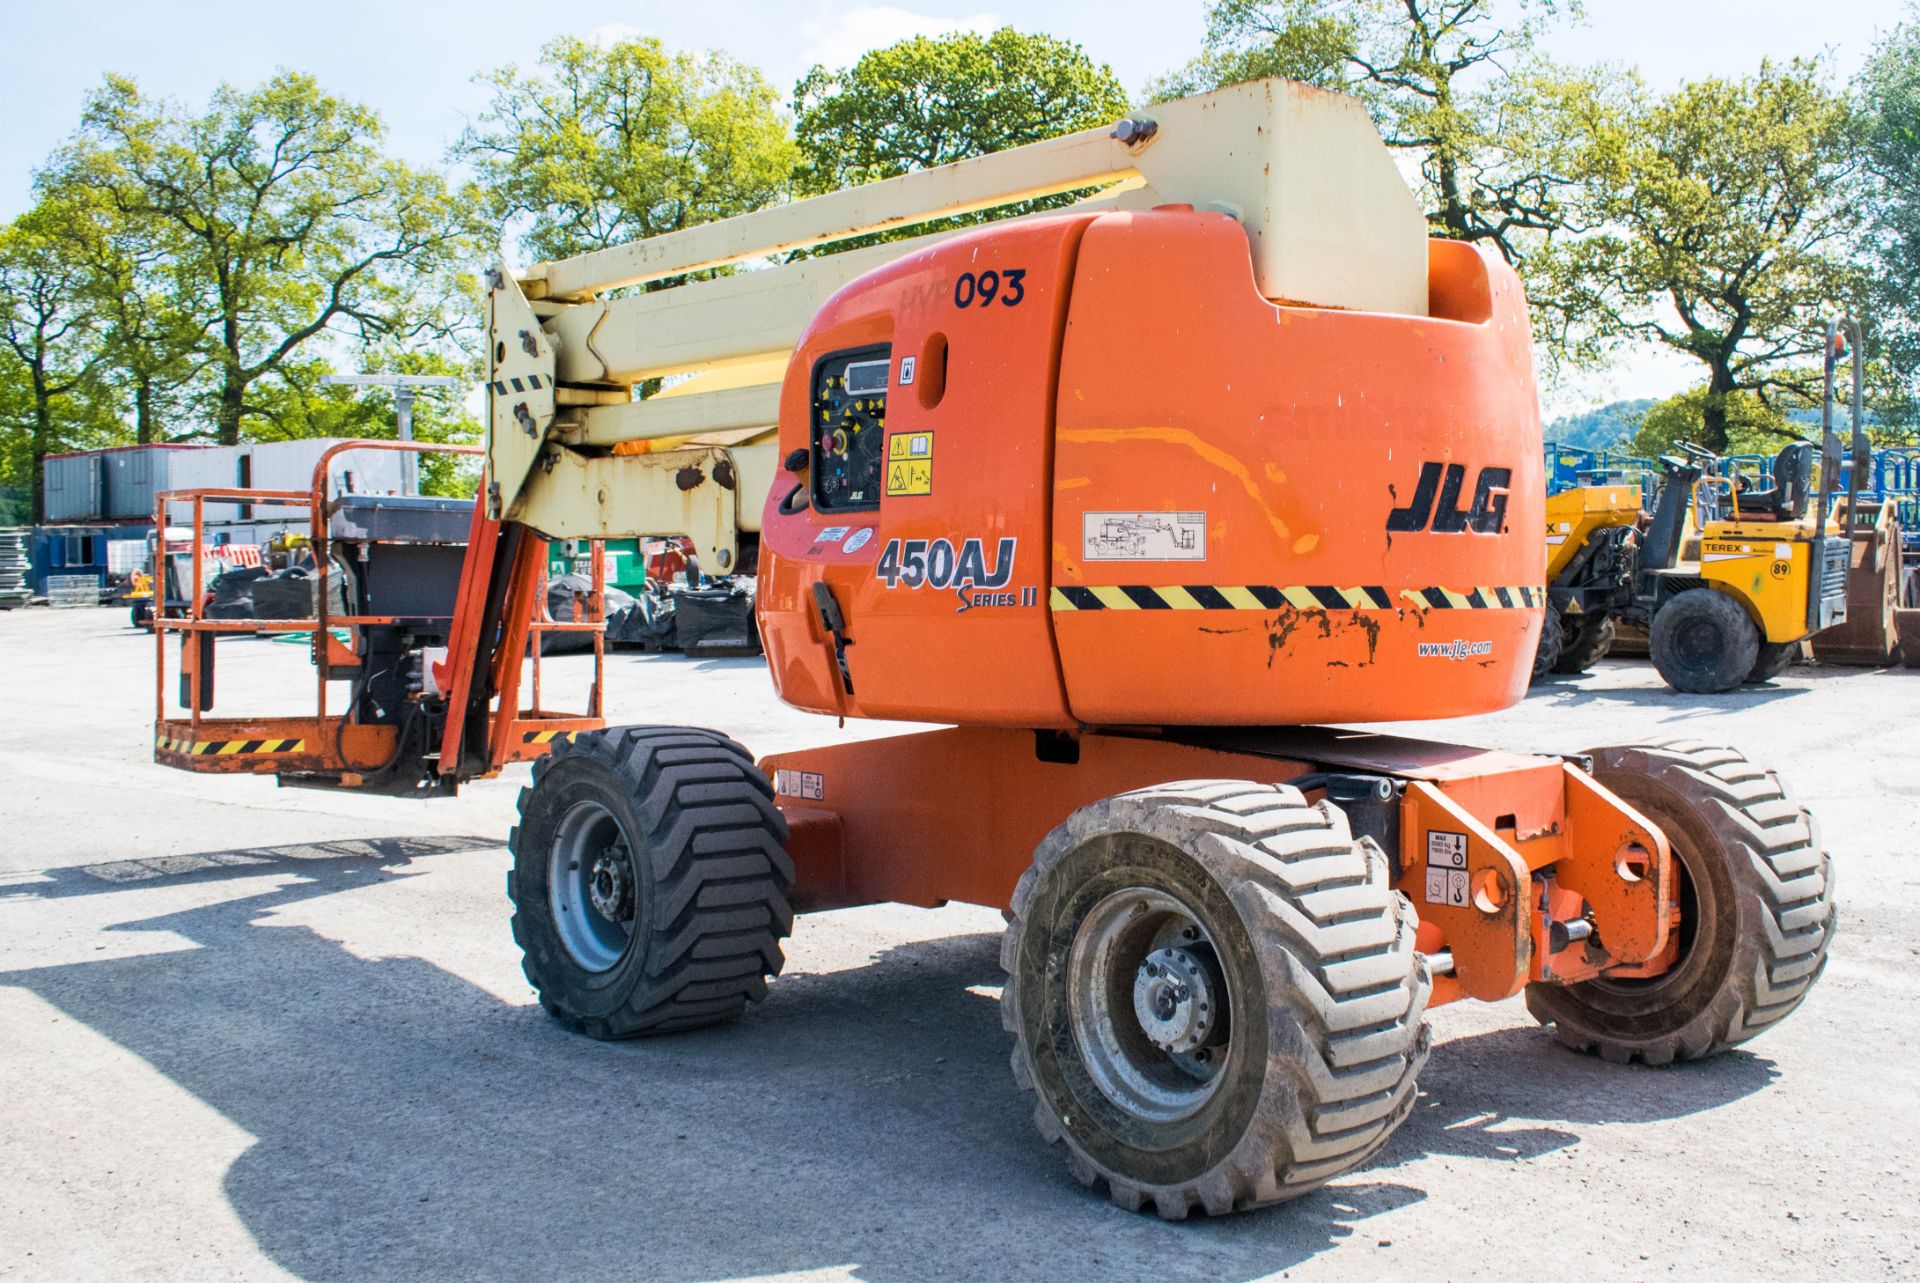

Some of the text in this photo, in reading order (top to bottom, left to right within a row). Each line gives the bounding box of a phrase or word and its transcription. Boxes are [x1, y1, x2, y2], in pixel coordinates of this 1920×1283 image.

[955, 268, 1026, 309] 093
[849, 491, 864, 500] JLG
[1386, 461, 1511, 534] JLG
[1705, 543, 1742, 553] TEREX
[876, 537, 1018, 590] 450AJ
[1773, 563, 1788, 575] 89
[956, 583, 1038, 613] SERIES II
[1418, 640, 1493, 659] www.jlg.com
